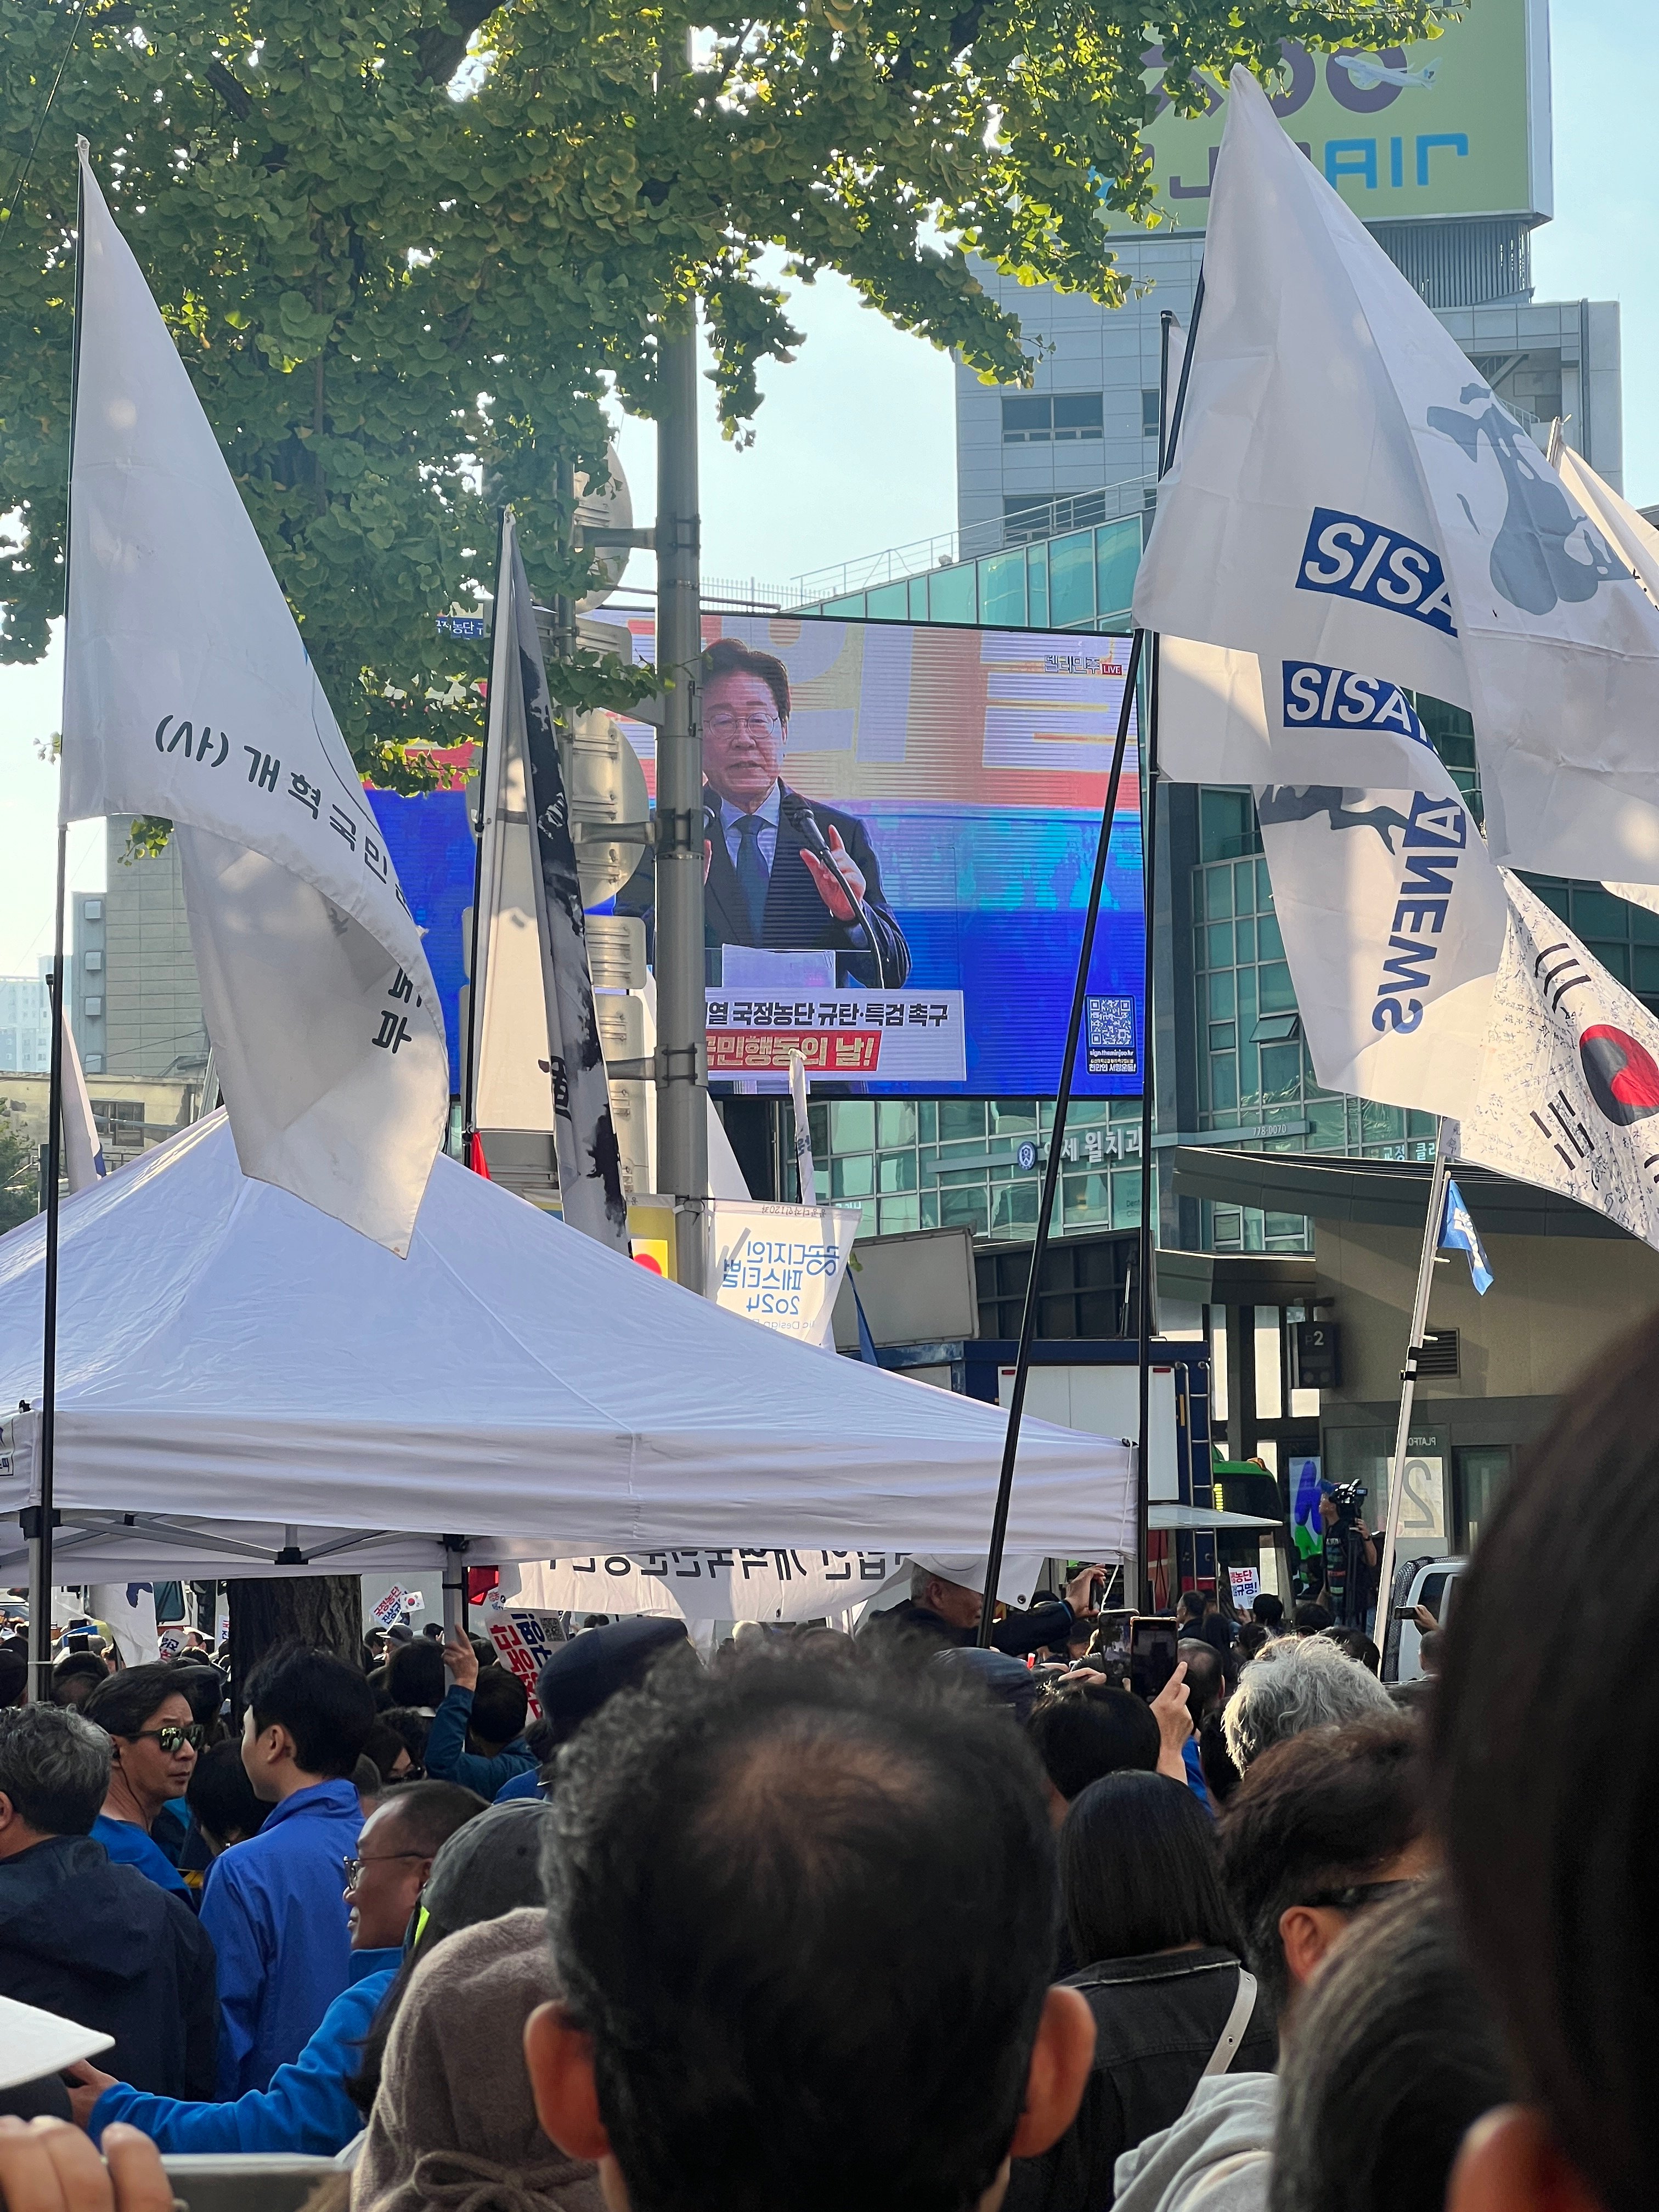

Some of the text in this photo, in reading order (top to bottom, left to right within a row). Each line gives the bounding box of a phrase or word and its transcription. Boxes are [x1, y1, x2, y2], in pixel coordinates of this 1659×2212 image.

[1103, 665, 1121, 675] LIVE
[733, 1002, 815, 1026] 국정농단
[908, 1003, 949, 1028] 촉구
[836, 1037, 875, 1067] 날!
